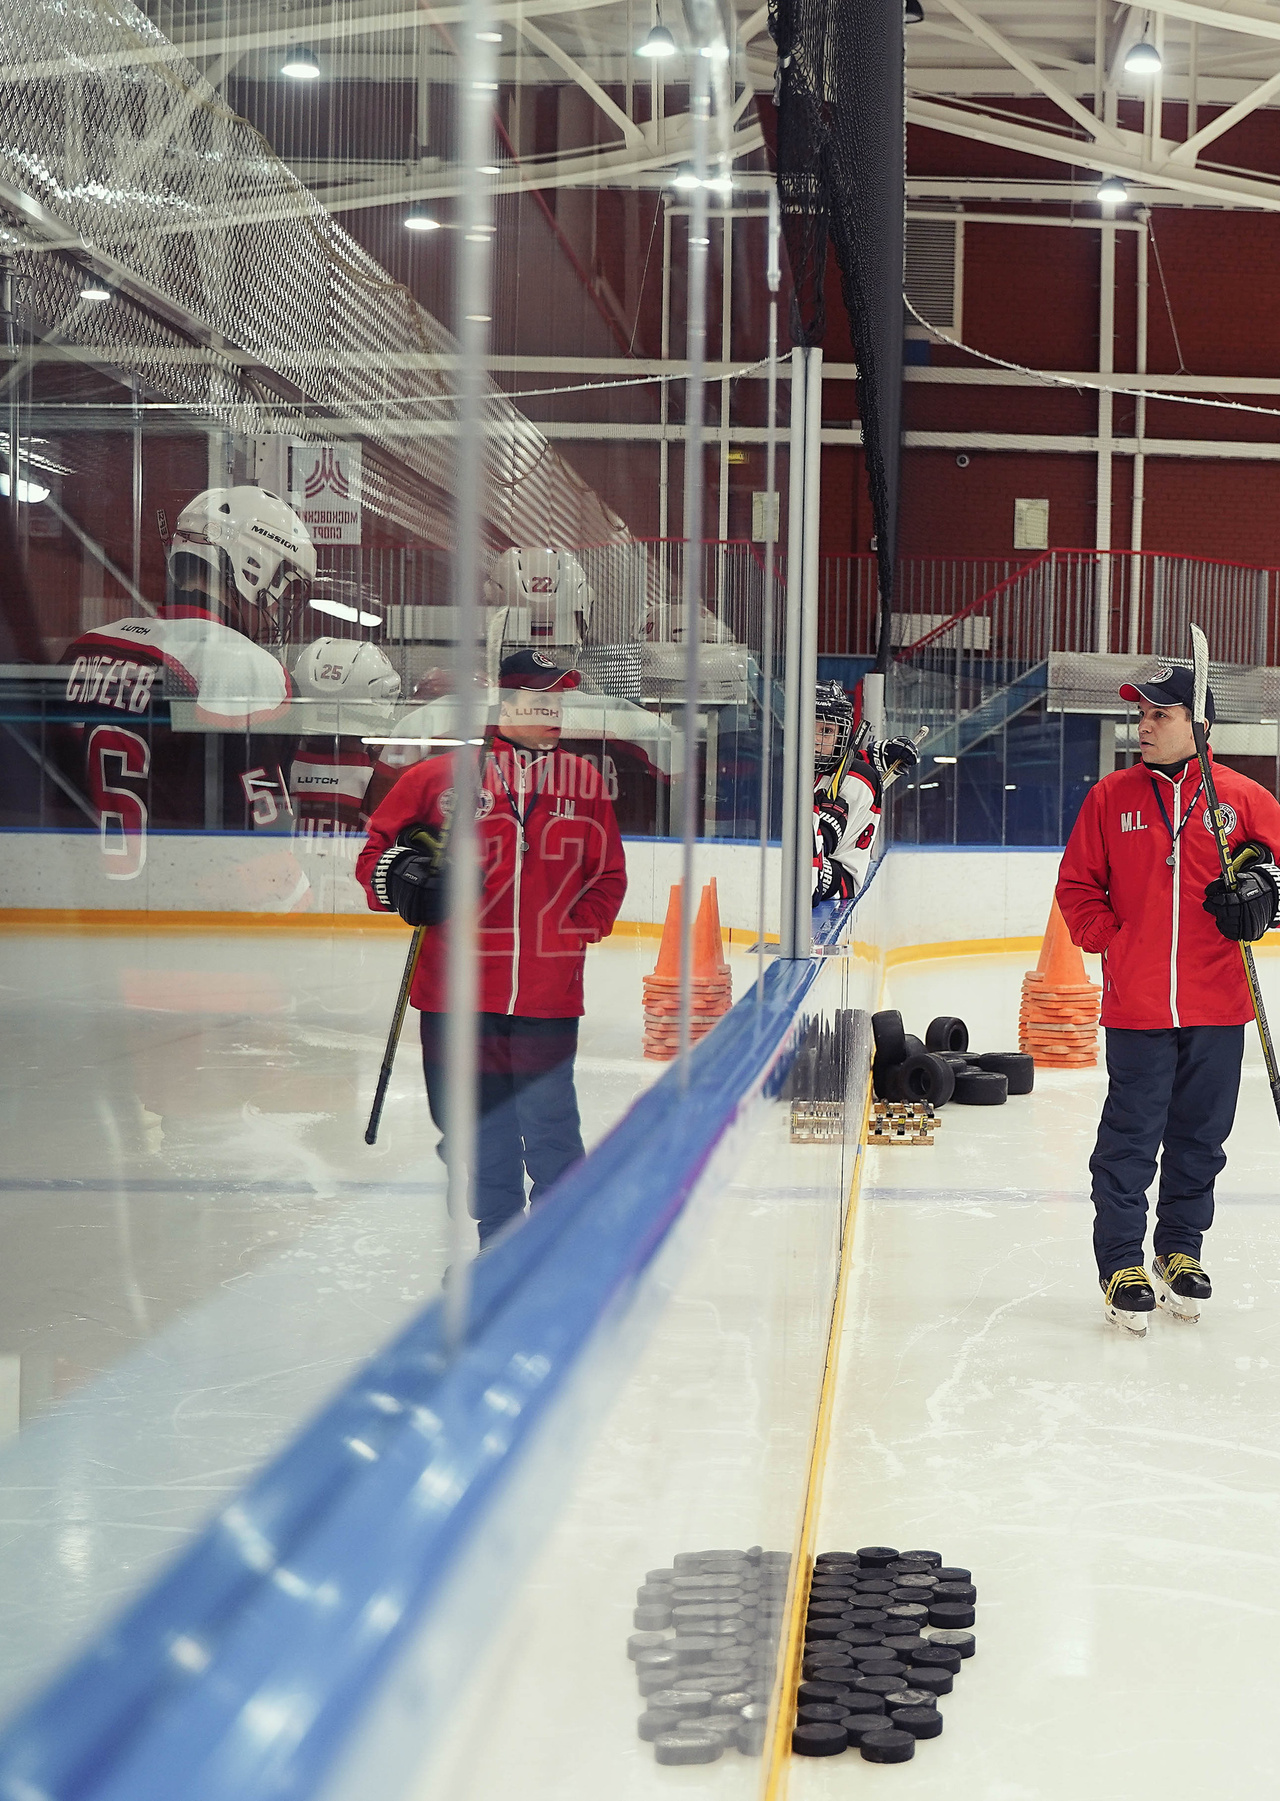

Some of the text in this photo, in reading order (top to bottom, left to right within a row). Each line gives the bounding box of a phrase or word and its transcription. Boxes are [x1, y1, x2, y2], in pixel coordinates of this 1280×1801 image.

[251, 525, 299, 552] MISSION
[531, 577, 552, 592] 22
[120, 624, 151, 635] LUTCH
[320, 664, 343, 680] 25
[515, 707, 559, 718] LUTCH
[297, 776, 339, 785] LUTCH
[1121, 810, 1148, 833] M.L.
[856, 823, 875, 850] 8
